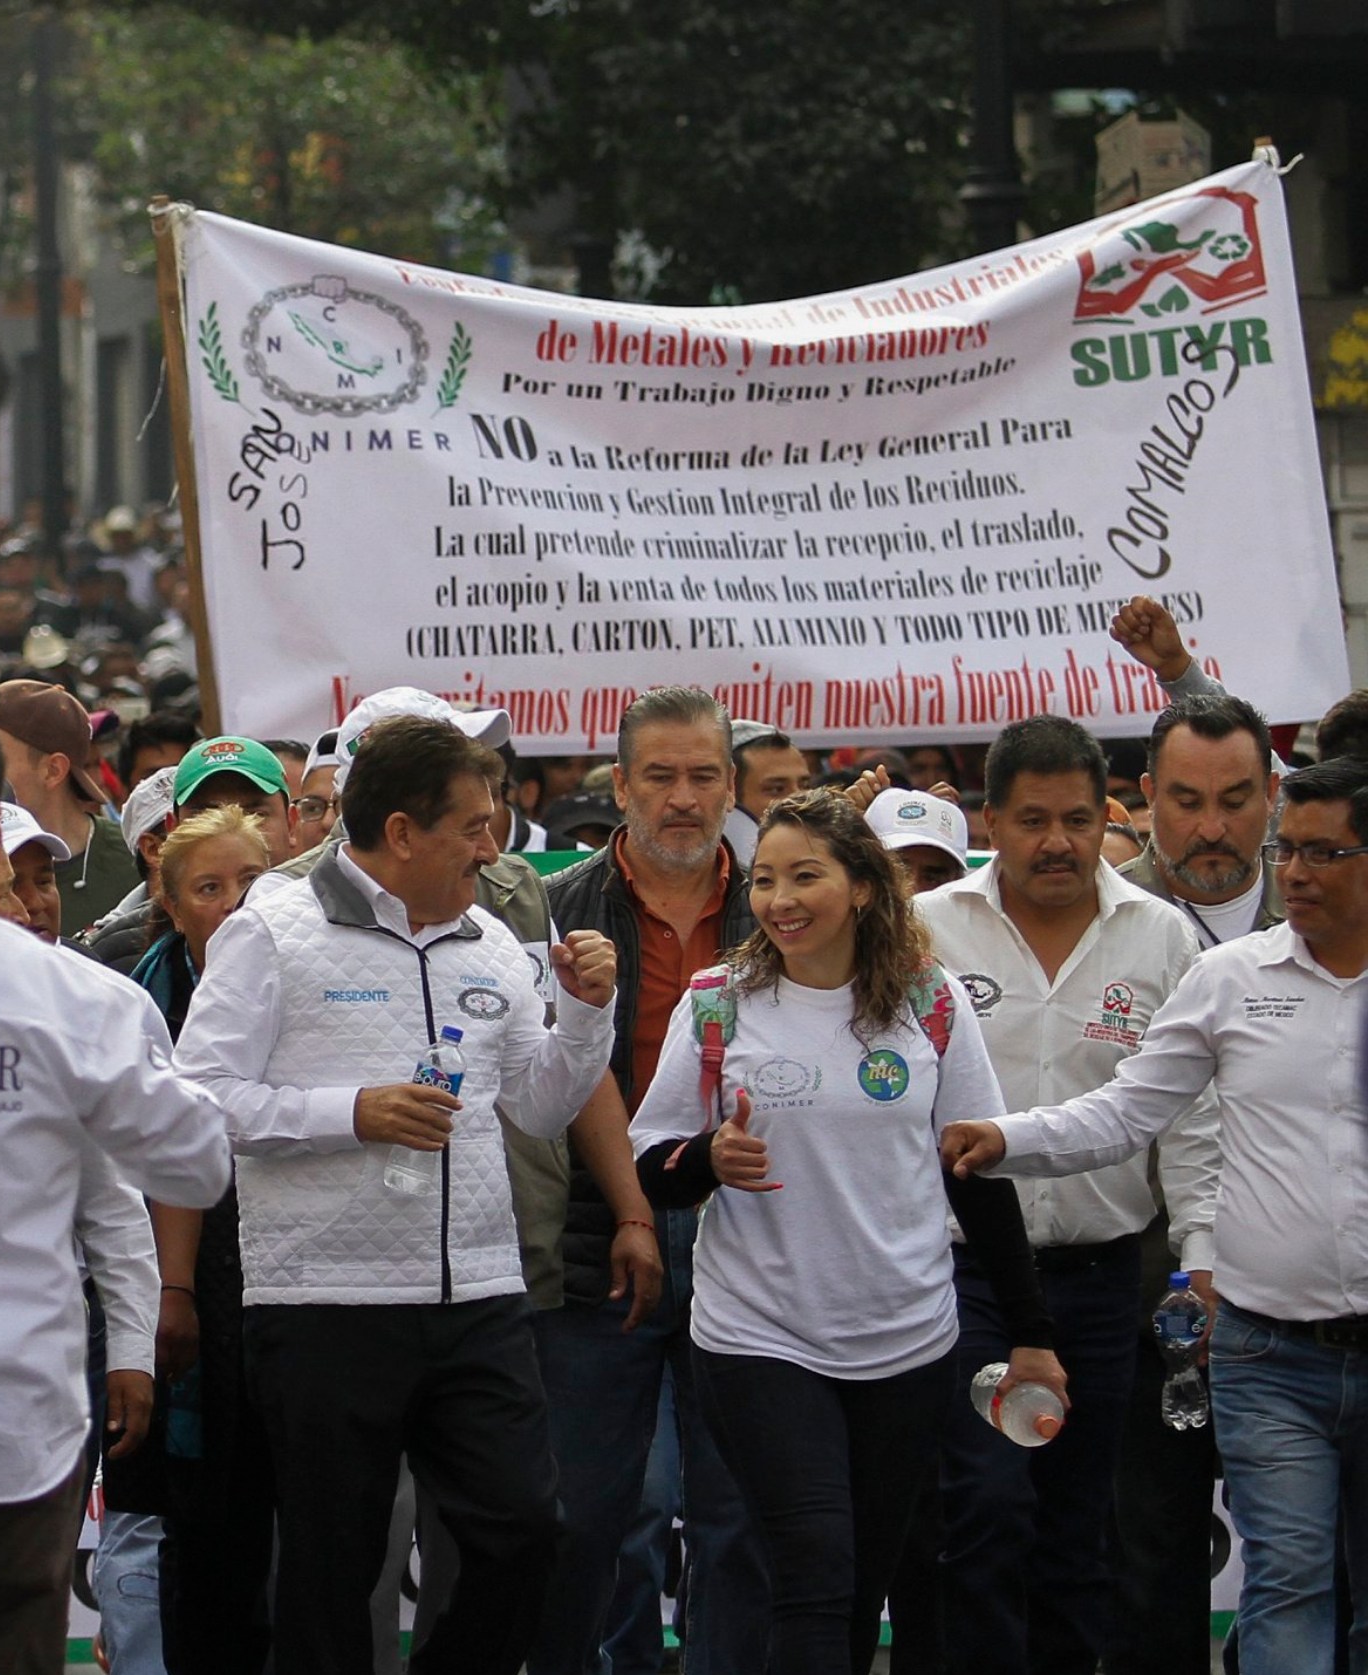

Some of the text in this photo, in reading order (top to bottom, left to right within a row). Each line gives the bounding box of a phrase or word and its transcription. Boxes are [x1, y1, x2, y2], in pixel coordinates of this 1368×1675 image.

[852, 250, 1068, 321] Industriales
[536, 319, 577, 363] de
[590, 319, 729, 368] Metales
[735, 337, 754, 375] y
[1070, 316, 1274, 389] SUTYR
[502, 355, 1017, 407] Por un Trabajo Digno y Respetable
[469, 413, 1073, 471] NO a la Reforma de la Ley General Para
[448, 469, 1027, 521] la Prevencion y Gestion Integral de los Reciduos.
[434, 509, 1085, 563] La cual pretende criminalizar la recepcio, el traslado,
[435, 554, 1104, 613] el acopio y la venta de todos los materiales de reciclaje
[406, 590, 1204, 659] (CHATARRA, CARTON, PET, ALUMINIO Y TODO TIPO DE MEES)
[823, 660, 946, 729] nuestra
[952, 653, 1056, 724] fuente
[1063, 647, 1100, 718] de
[323, 990, 390, 1003] PRESIDENTE
[753, 1099, 815, 1112] CONIMER
